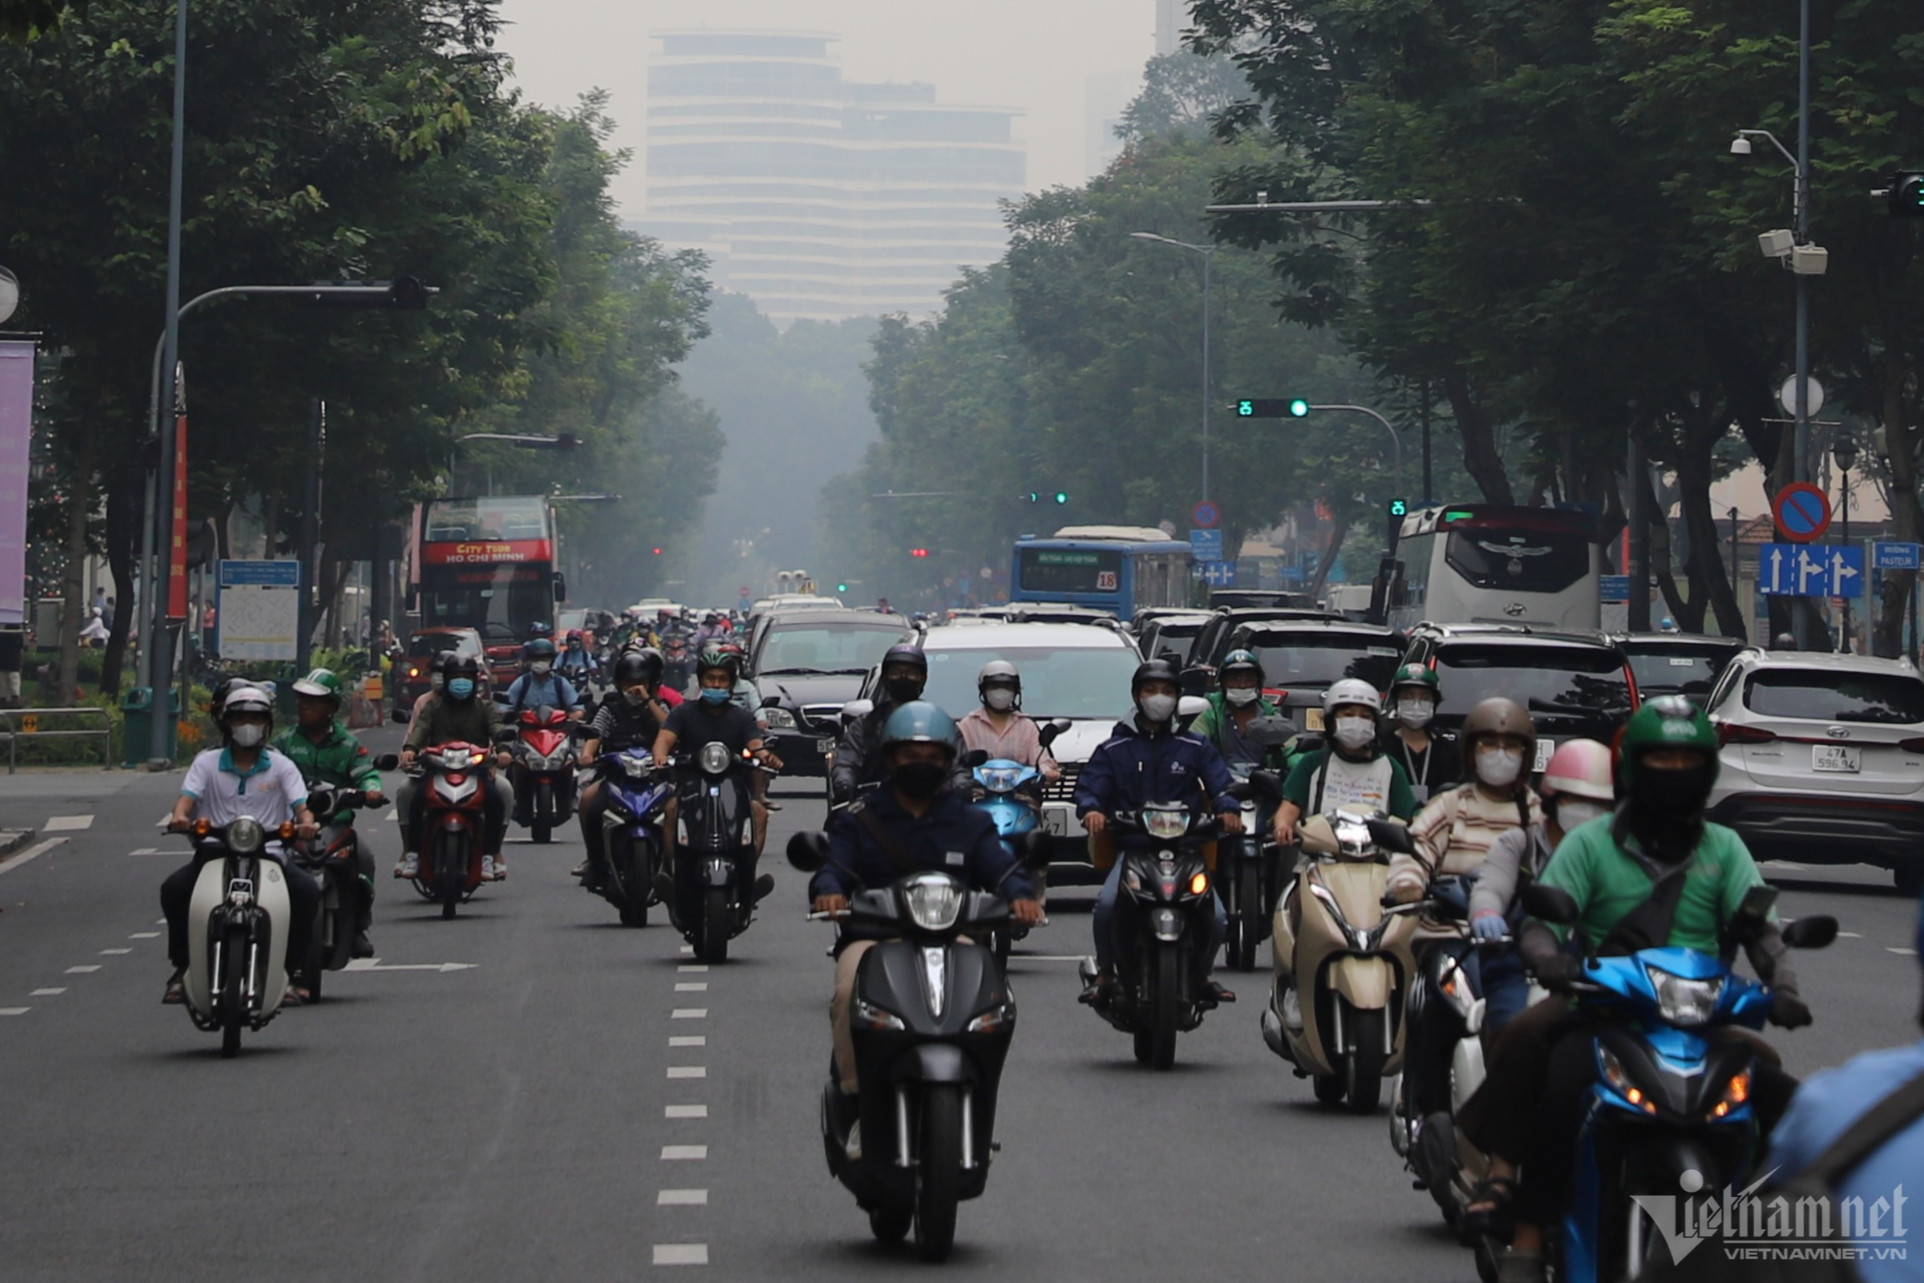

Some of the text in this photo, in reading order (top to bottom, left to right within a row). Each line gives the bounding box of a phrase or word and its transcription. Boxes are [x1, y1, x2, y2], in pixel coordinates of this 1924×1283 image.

[492, 553, 524, 562] MINH
[1099, 574, 1115, 588] 18
[1826, 748, 1847, 758] 47A
[1817, 758, 1855, 770] 596.94
